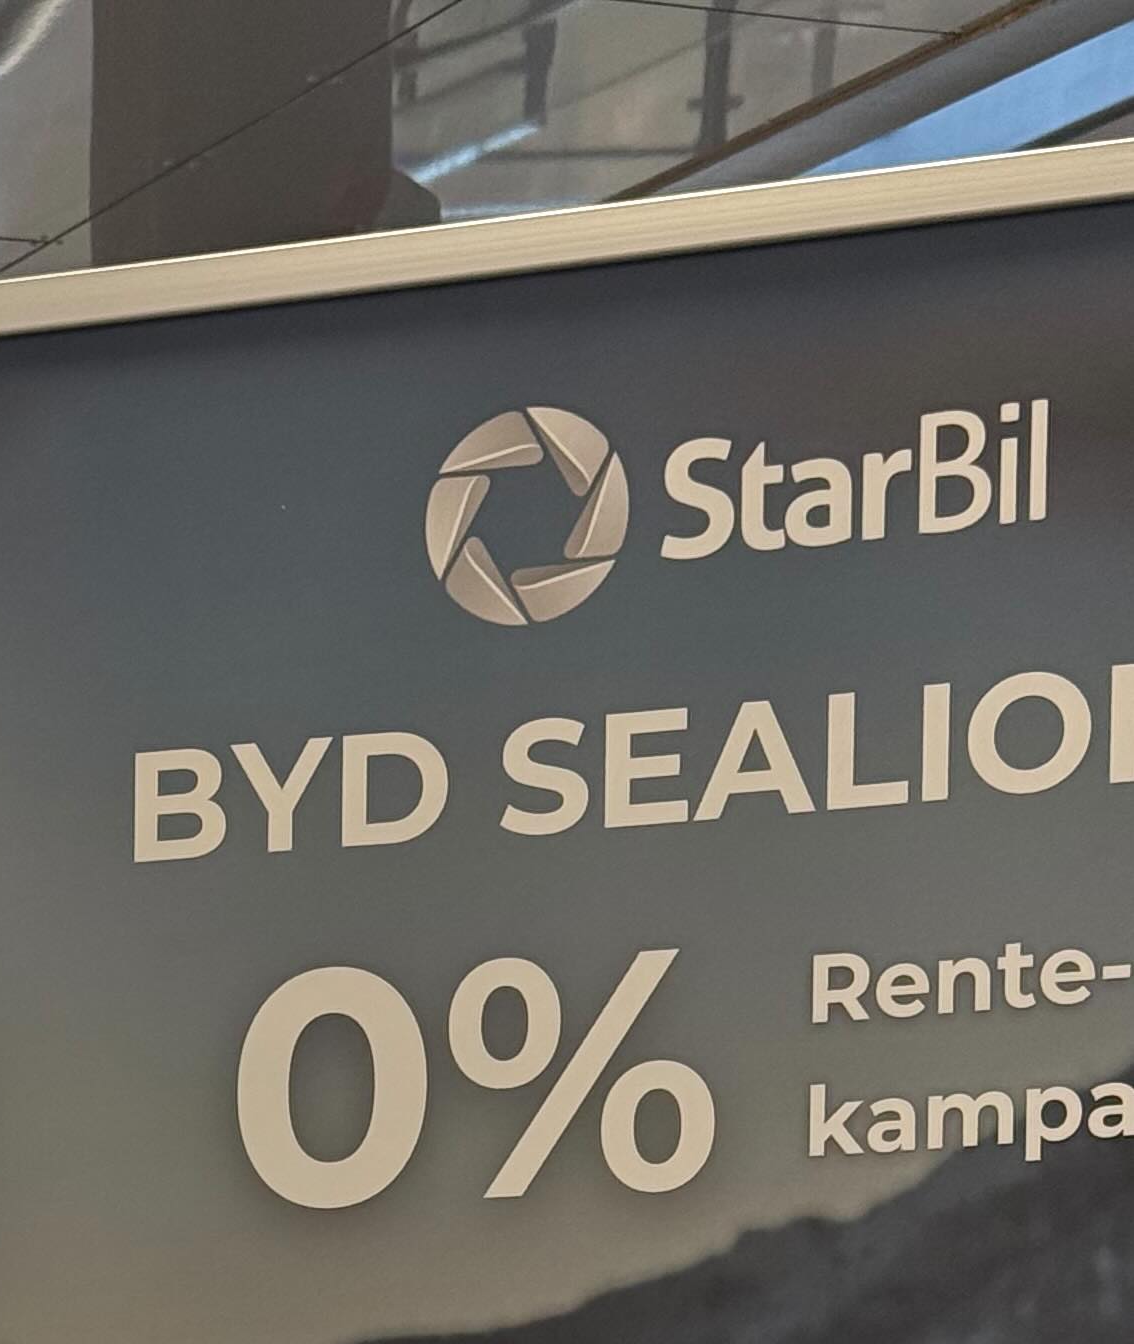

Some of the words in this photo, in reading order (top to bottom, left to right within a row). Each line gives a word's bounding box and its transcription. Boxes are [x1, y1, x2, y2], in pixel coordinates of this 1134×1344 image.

[660, 398, 1049, 560] StarBil
[133, 731, 450, 863] BYD
[498, 663, 1134, 836] SEALIO
[810, 942, 1132, 1024] Rente-
[235, 948, 716, 1209] 0%
[807, 1081, 1134, 1162] kampa
